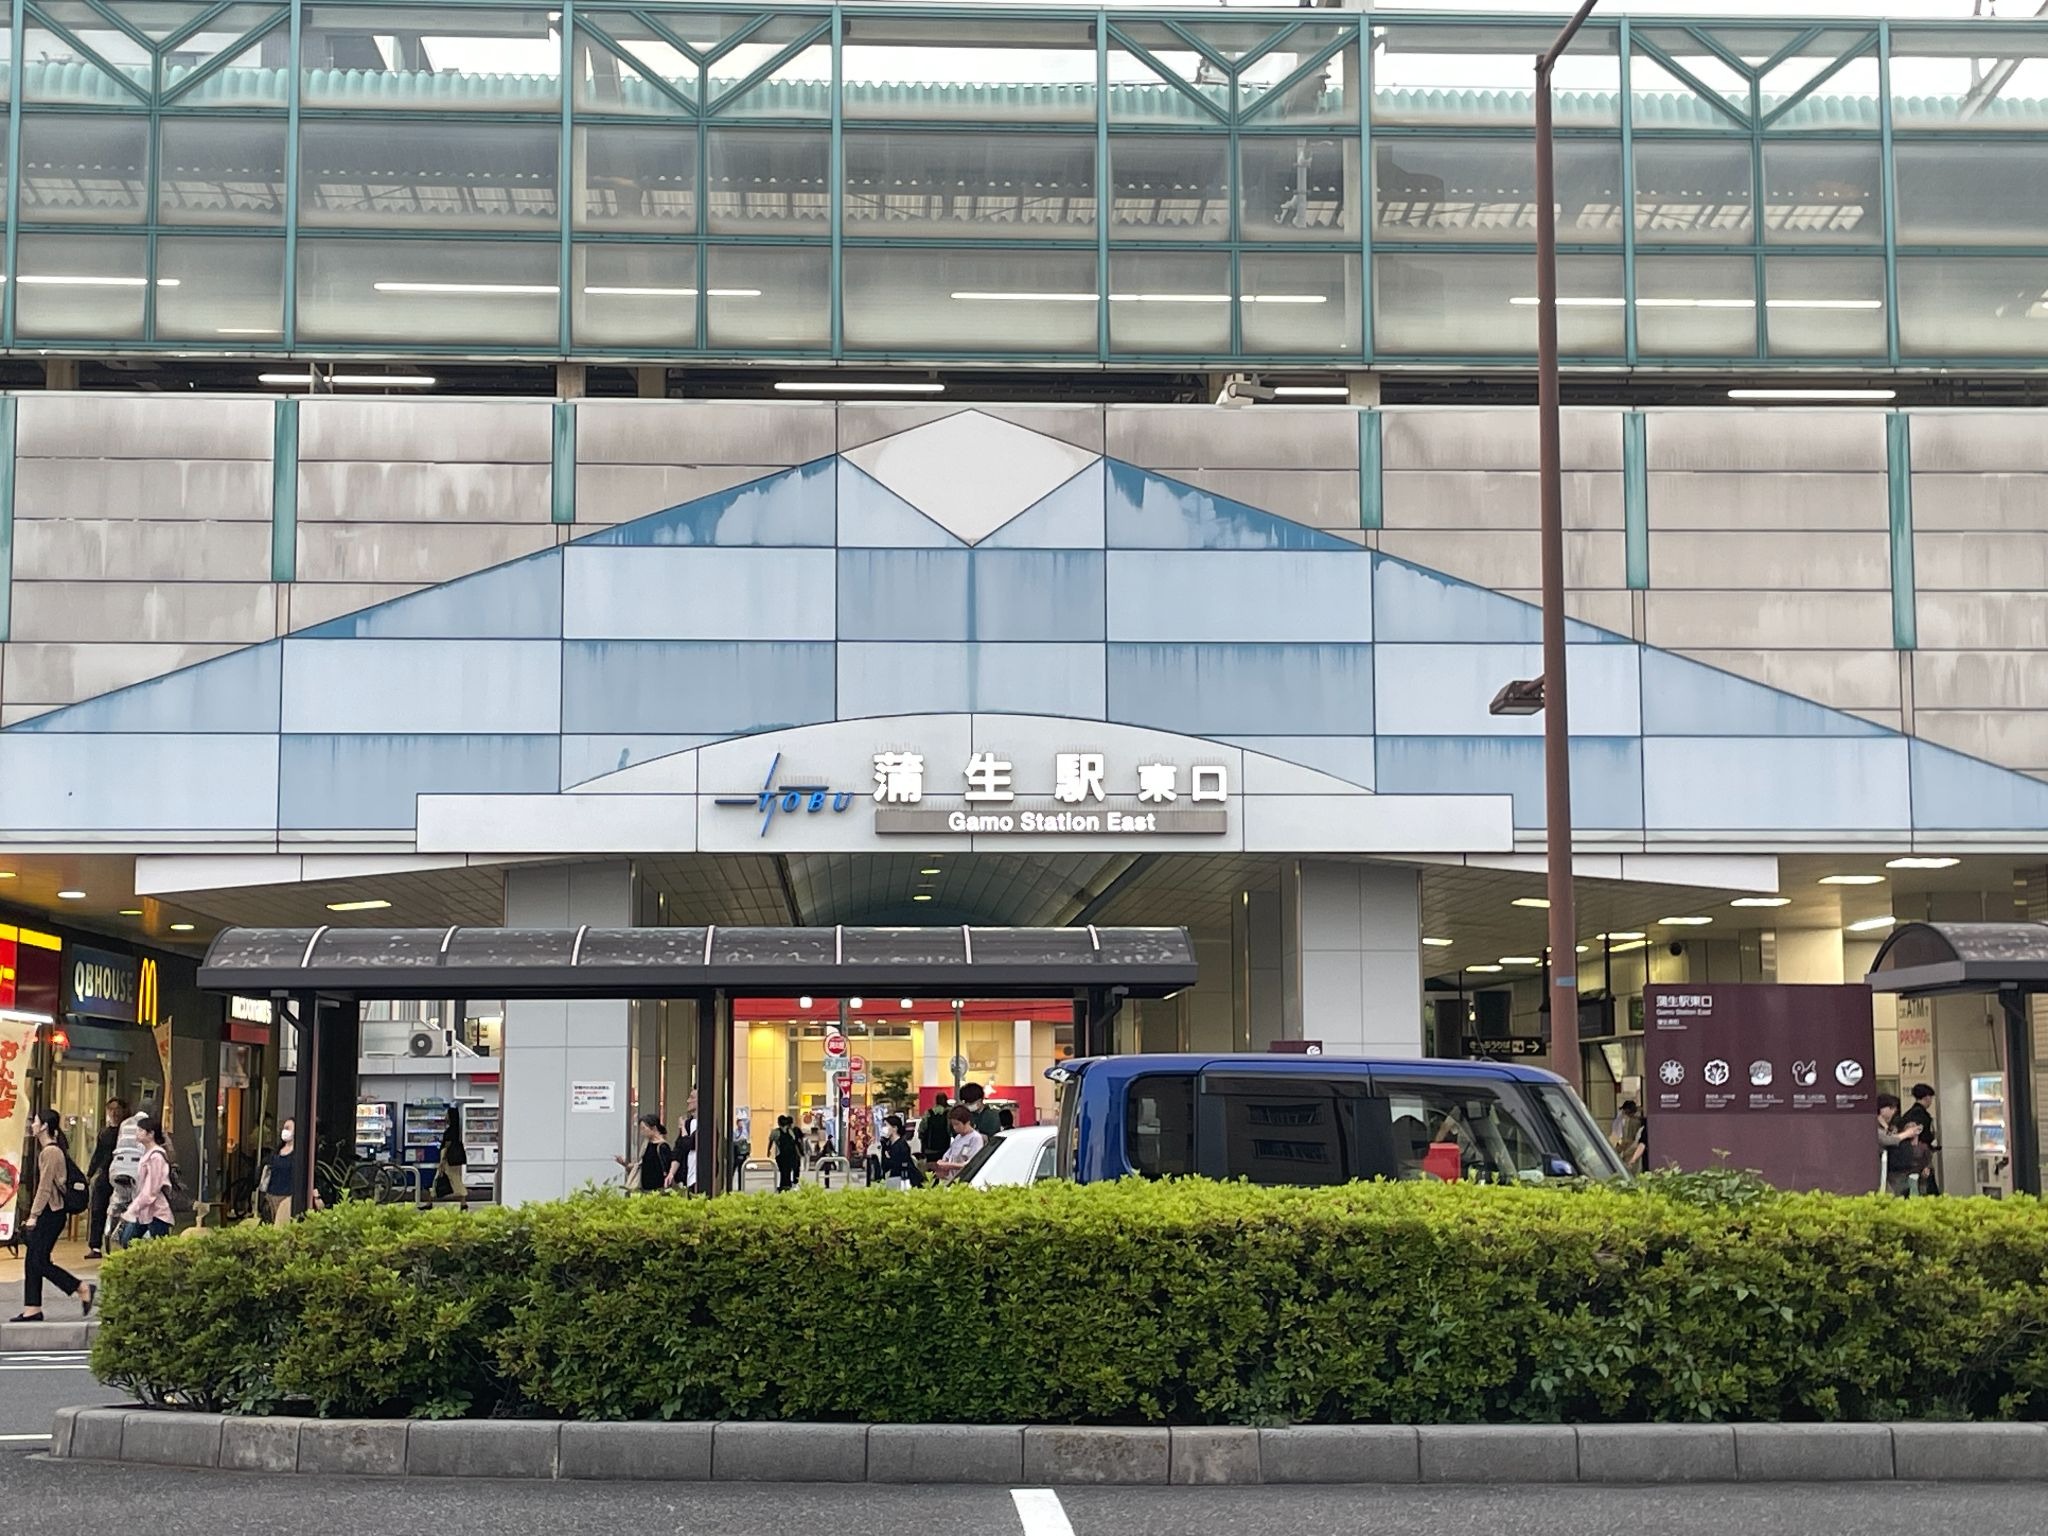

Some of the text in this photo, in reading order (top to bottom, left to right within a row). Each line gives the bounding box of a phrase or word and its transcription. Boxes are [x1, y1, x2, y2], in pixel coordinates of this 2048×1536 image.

[873, 751, 1227, 802] 蒲生駅東口
[949, 812, 1156, 831] Gamo Station East
[1656, 995, 1712, 1007] 蒲生駅東口
